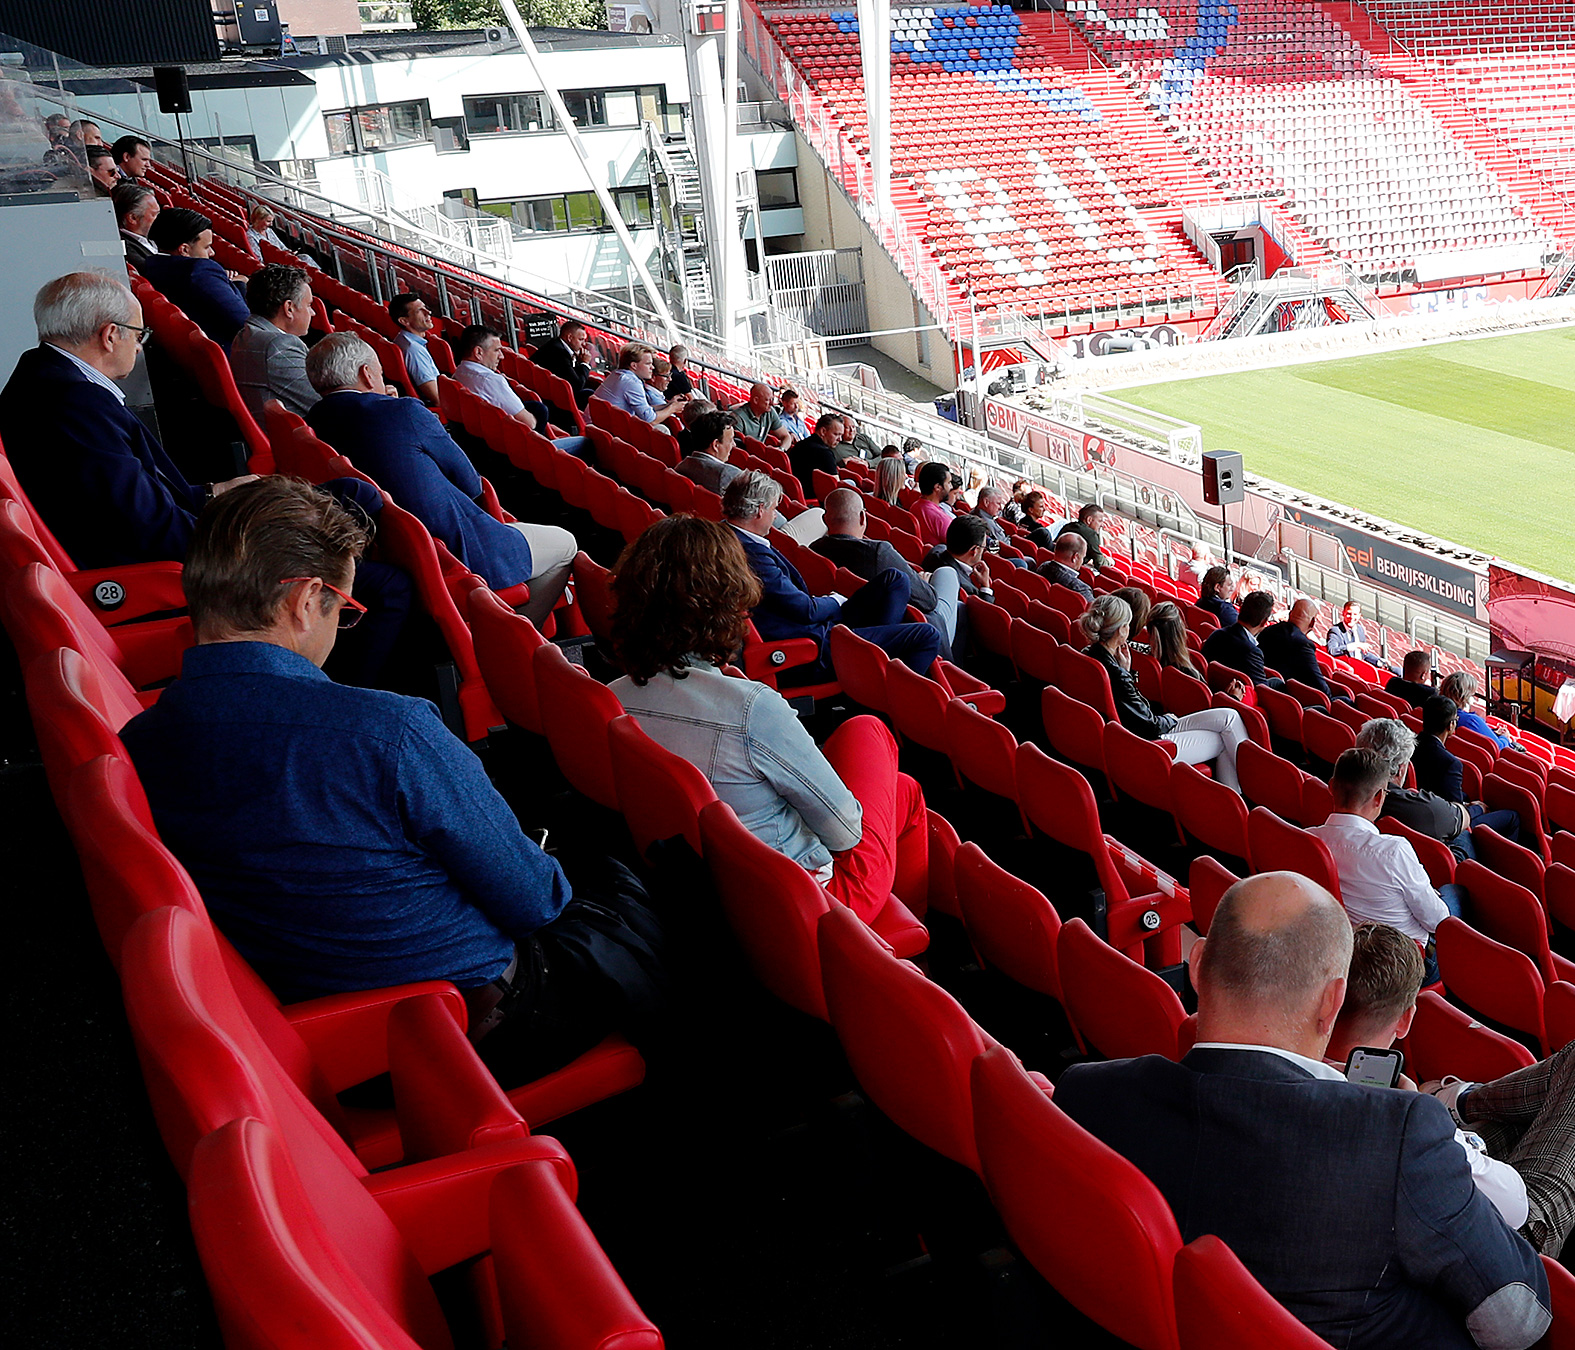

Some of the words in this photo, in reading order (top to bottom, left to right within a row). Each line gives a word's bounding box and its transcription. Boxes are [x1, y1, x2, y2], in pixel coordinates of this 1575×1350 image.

[1376, 556, 1475, 608] BEDRIJFSKLEDING
[100, 585, 119, 600] 28
[1145, 914, 1158, 926] 25
